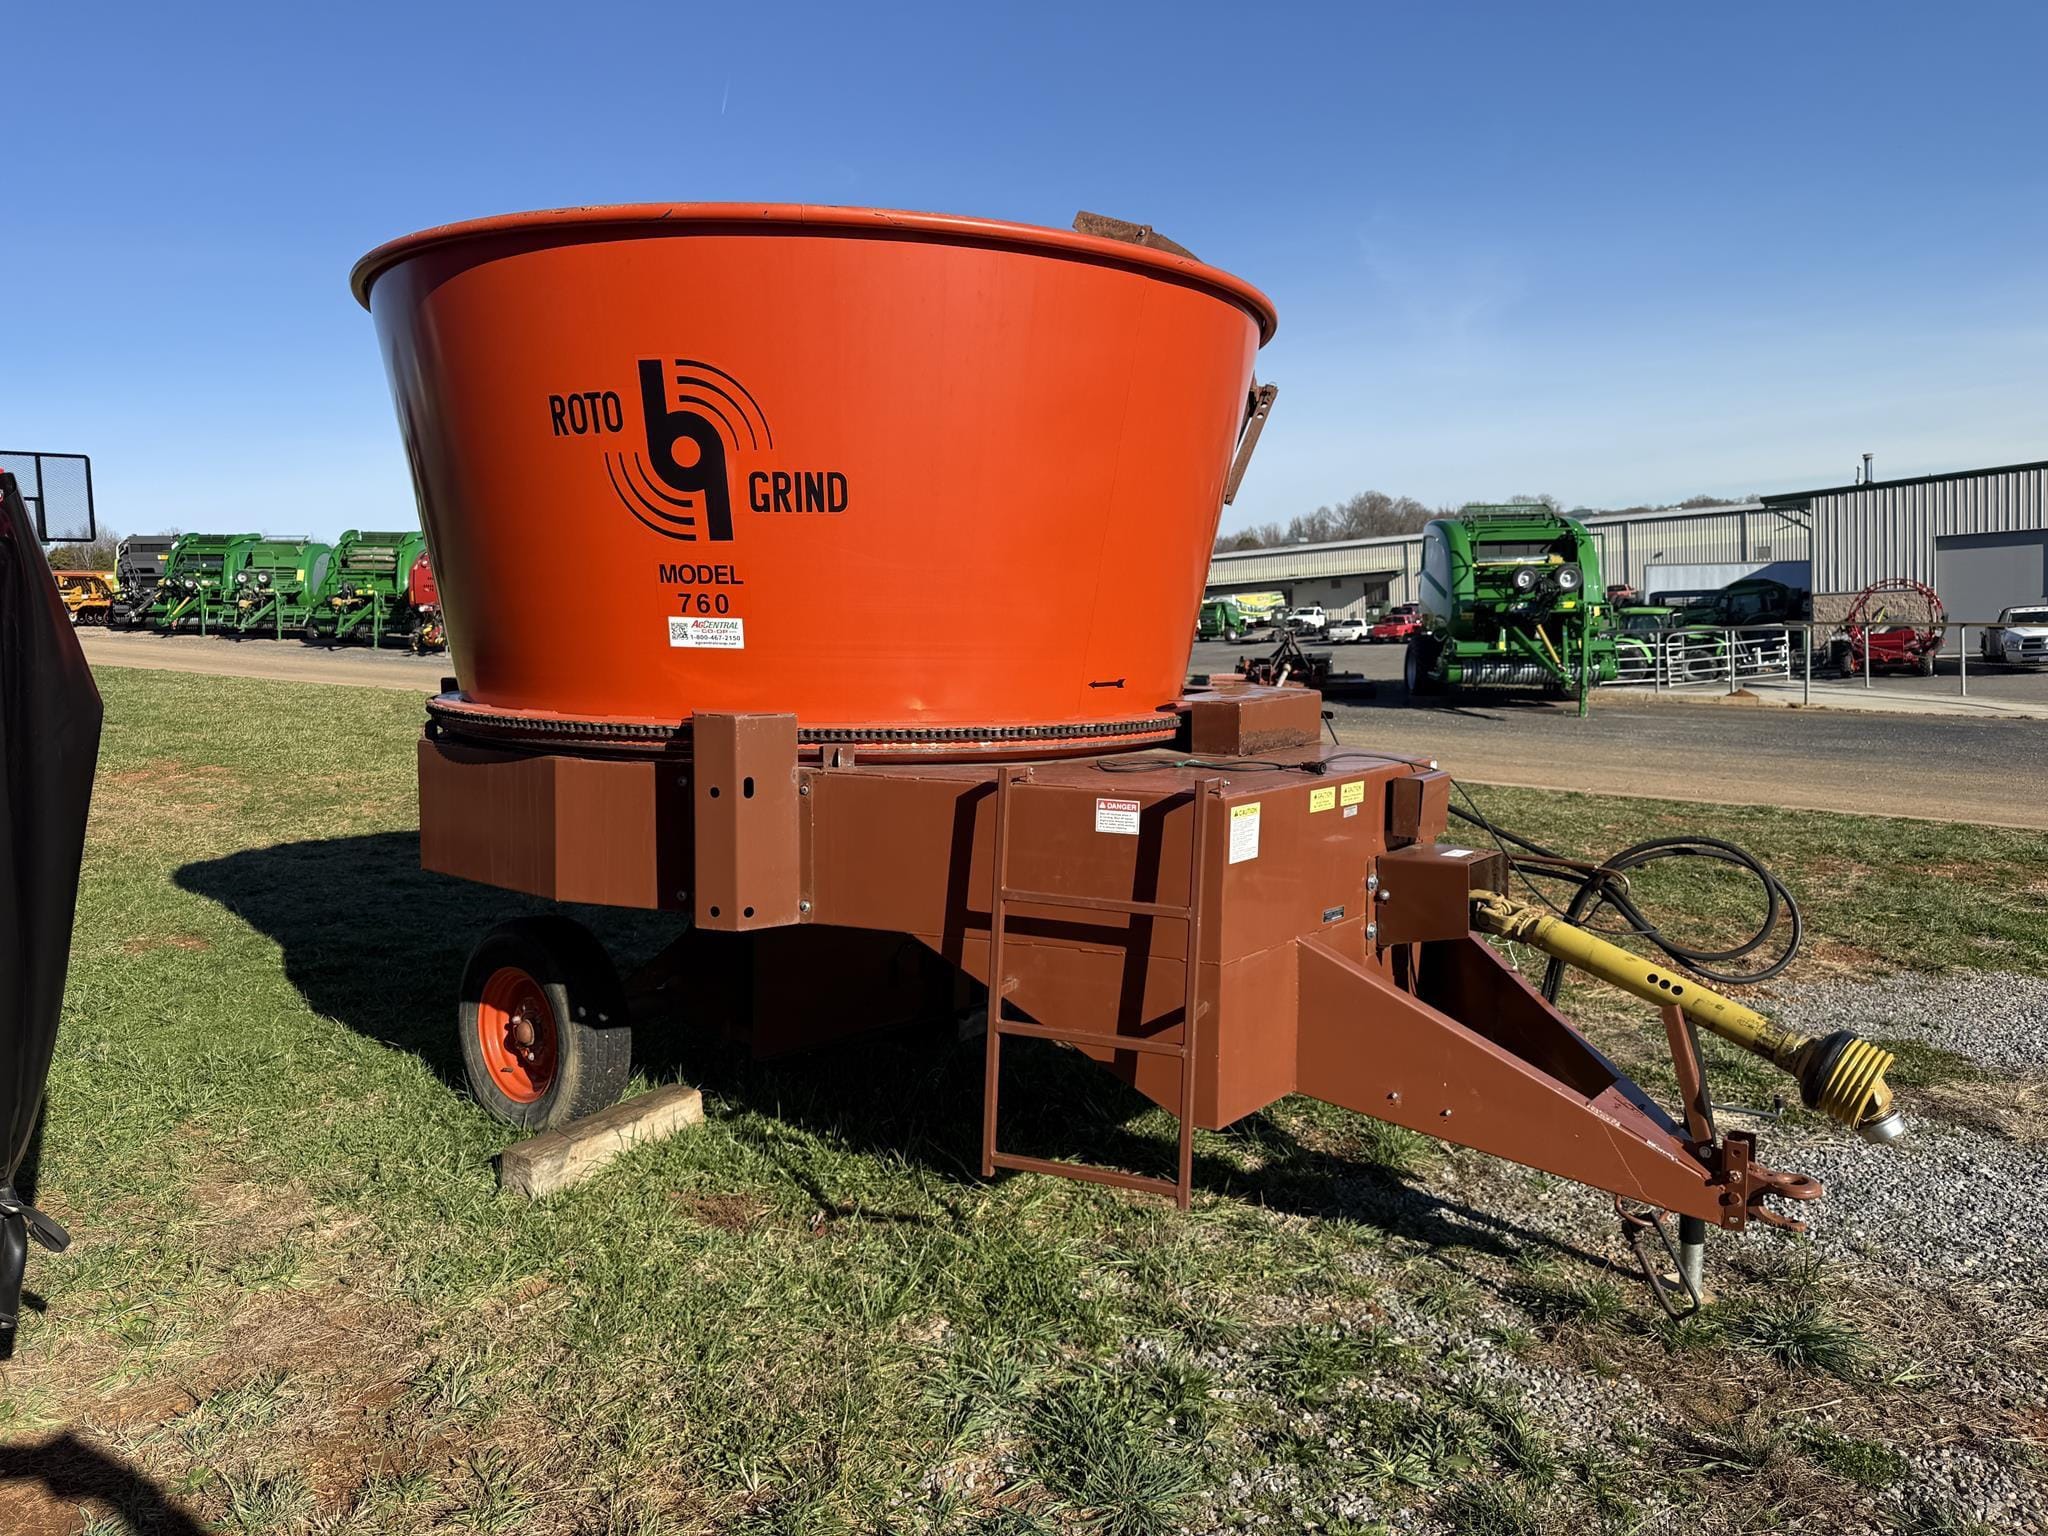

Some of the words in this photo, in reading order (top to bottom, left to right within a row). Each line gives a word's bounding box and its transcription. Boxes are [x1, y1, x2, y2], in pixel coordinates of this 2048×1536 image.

[549, 391, 624, 437] ROTO
[748, 471, 848, 513] GRIND
[659, 564, 744, 585] MODEL
[678, 593, 729, 615] 760
[1107, 802, 1137, 811] DANGER
